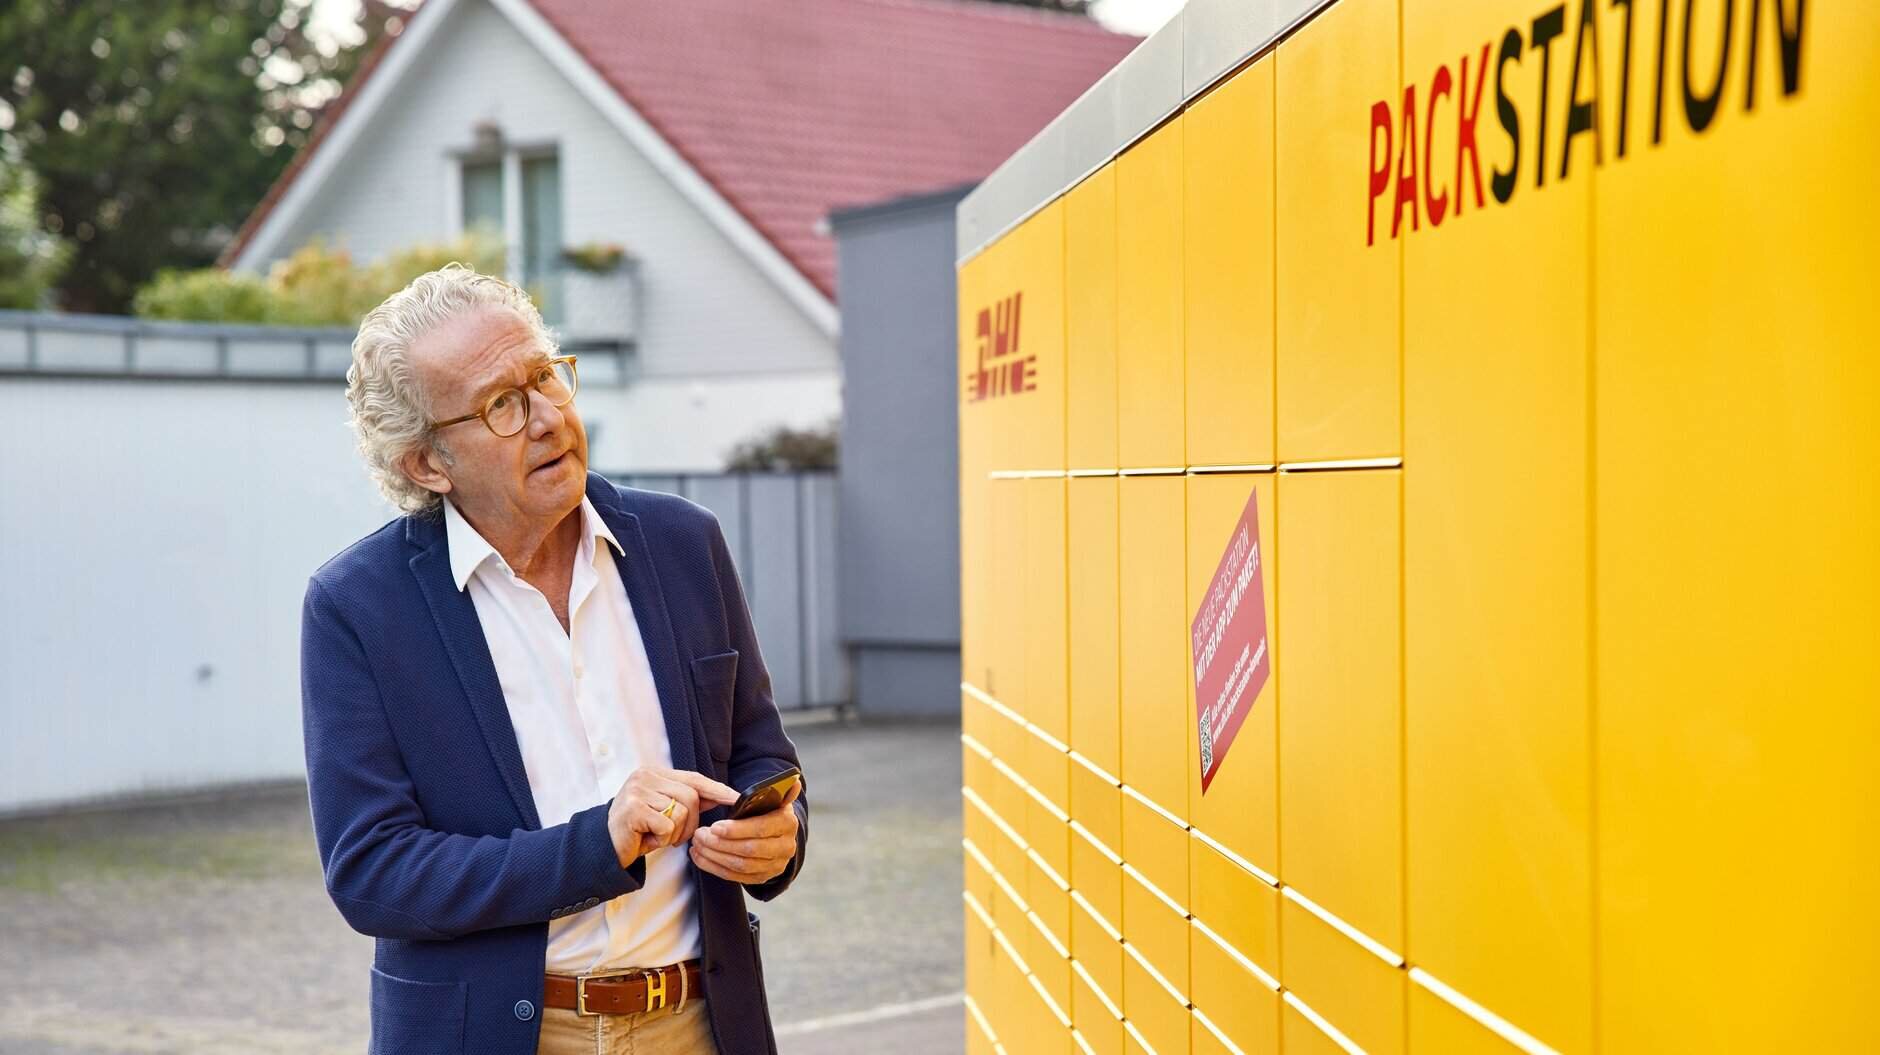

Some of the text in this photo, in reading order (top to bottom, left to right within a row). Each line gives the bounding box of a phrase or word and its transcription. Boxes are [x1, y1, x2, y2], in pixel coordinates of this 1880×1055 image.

[973, 290, 1030, 400] DHL
[1193, 521, 1248, 656] DIE NEUE PACKSTATION
[1196, 540, 1258, 688] MIT DER APP ZUM PAKET!
